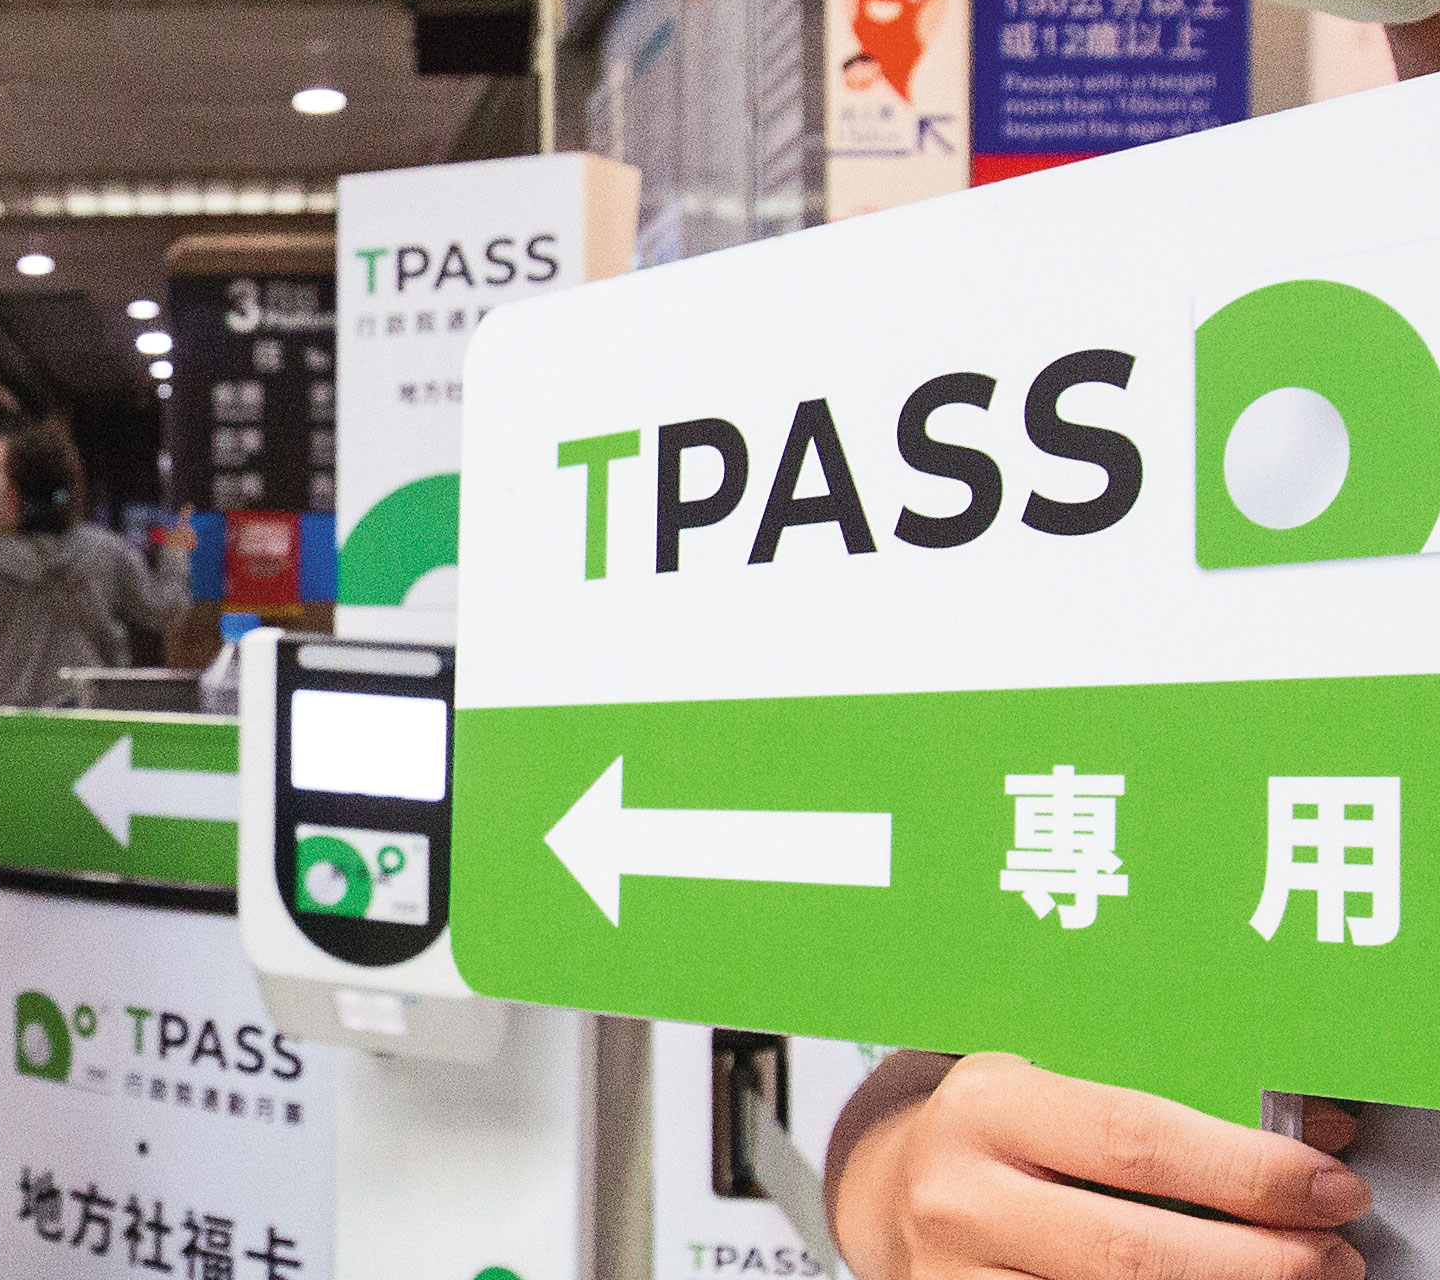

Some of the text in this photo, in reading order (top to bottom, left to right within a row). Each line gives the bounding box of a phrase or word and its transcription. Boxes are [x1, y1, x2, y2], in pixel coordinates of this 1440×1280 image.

[355, 234, 561, 294] TPASS
[225, 278, 262, 333] 3
[557, 348, 1144, 581] TPASS
[124, 1005, 303, 1081] TPASS
[690, 1243, 822, 1278] TPASS
